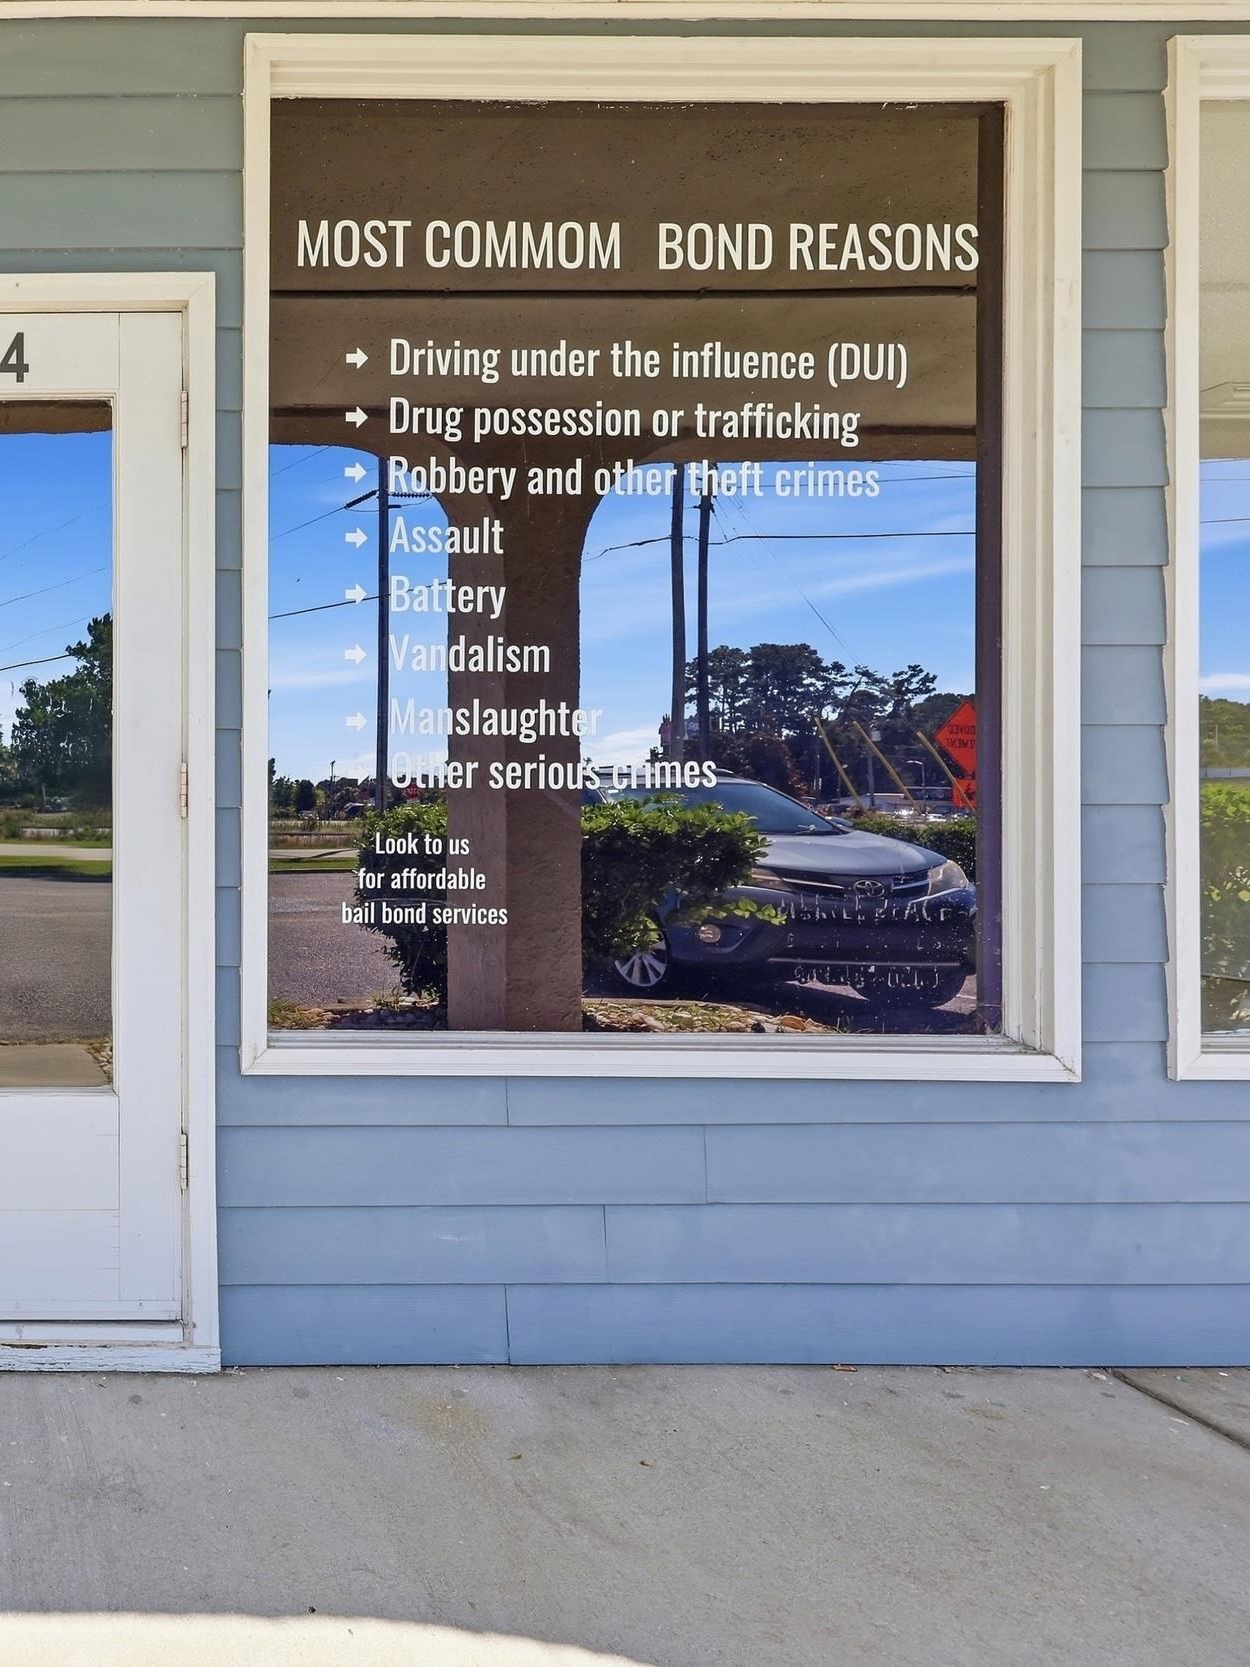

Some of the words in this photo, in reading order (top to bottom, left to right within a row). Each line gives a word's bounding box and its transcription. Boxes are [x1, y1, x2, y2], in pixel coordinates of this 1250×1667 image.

[297, 220, 412, 269] MOST
[425, 220, 622, 270] COMMOM
[658, 222, 774, 271] BOND
[789, 222, 980, 272] REASONS
[390, 338, 500, 384] Driving
[510, 338, 600, 378] under
[611, 339, 661, 379] the
[672, 340, 816, 380] influence
[827, 342, 909, 389] (DUI)
[389, 397, 463, 443] Drug
[473, 399, 643, 443] possession
[652, 409, 686, 437] or
[695, 402, 861, 446] trafficking
[388, 455, 516, 500] Robbery
[528, 457, 584, 496] and
[594, 458, 678, 497] other
[687, 459, 764, 498] theft
[775, 461, 880, 498] crimes
[389, 516, 504, 555] Assault
[390, 575, 506, 619] Battery
[388, 635, 551, 673] Vandalism
[389, 698, 603, 743] Manslaughter
[391, 752, 479, 789] Other
[489, 754, 601, 790] serious
[612, 758, 718, 789] crimes
[374, 832, 418, 855] Look
[424, 834, 443, 856] to
[449, 838, 470, 856] us
[357, 867, 385, 890] for
[390, 867, 487, 891] affordable
[341, 900, 376, 923] bail
[382, 901, 427, 924] bond
[433, 903, 508, 926] services
